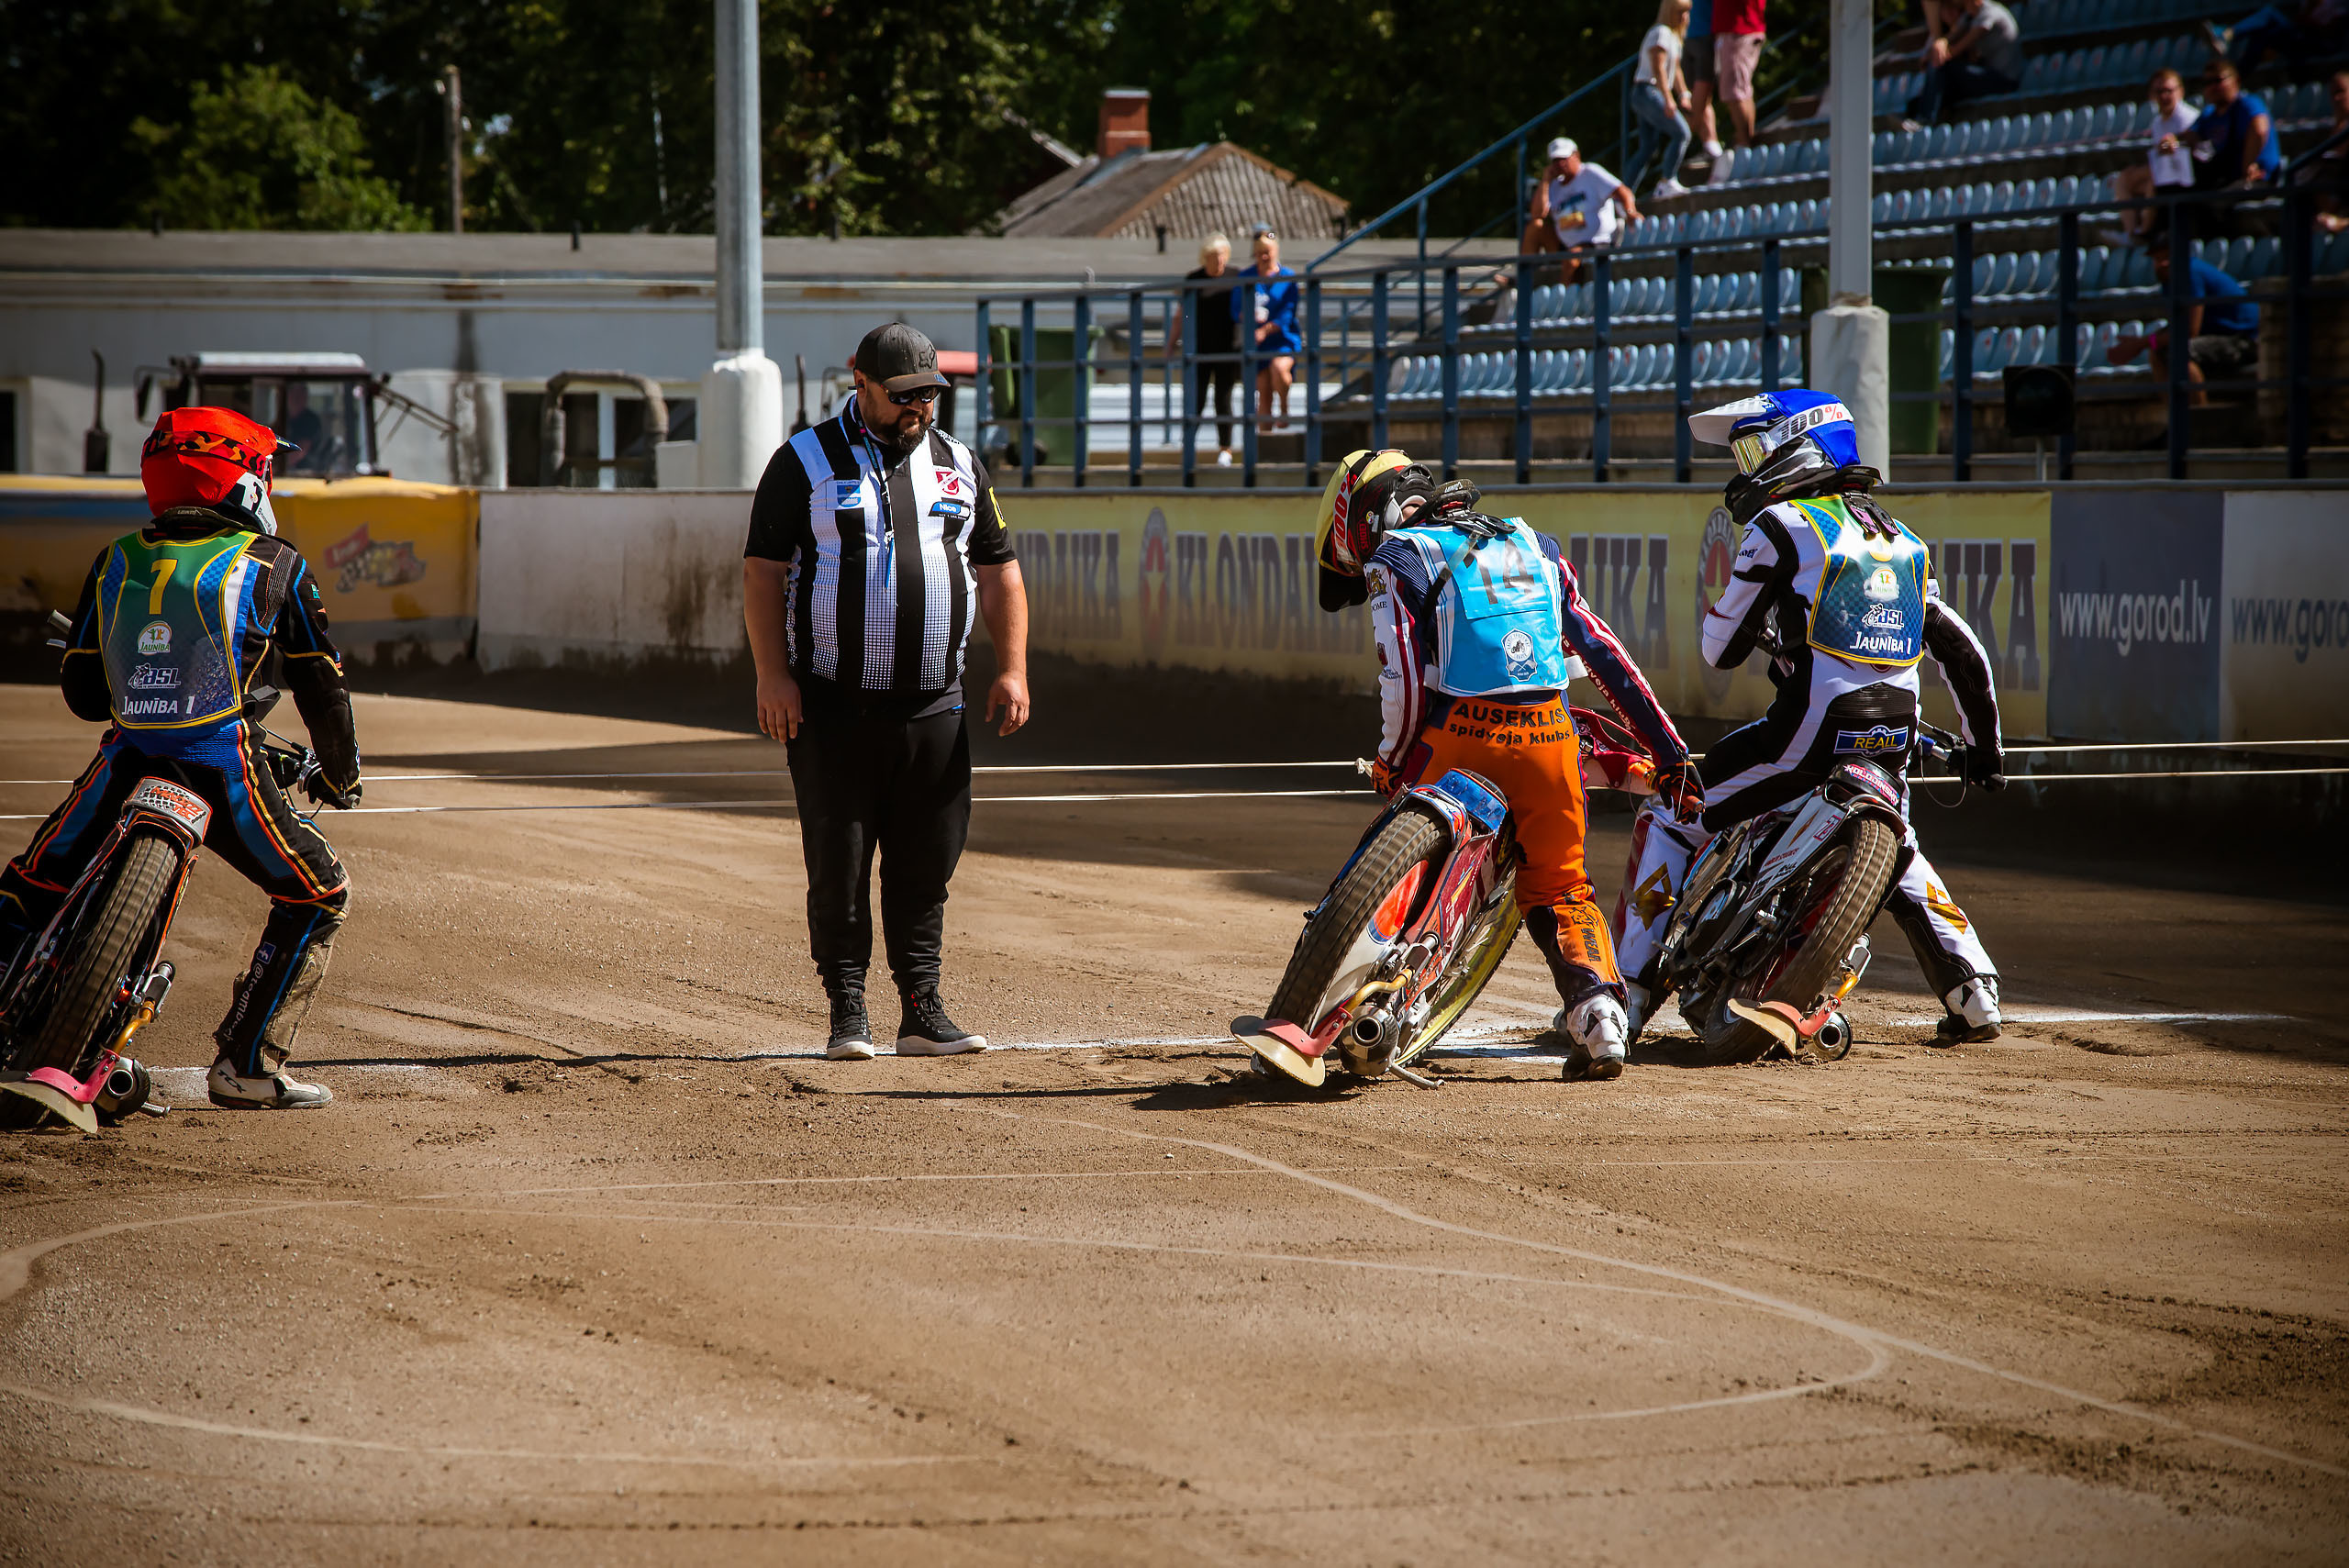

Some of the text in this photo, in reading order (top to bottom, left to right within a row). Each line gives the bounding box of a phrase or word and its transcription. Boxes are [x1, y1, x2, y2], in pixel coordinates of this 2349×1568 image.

[1781, 405, 1843, 442] 100%
[149, 559, 178, 615] 7
[1464, 538, 1535, 606] 14
[1371, 601, 1387, 612] OME
[2059, 579, 2212, 657] www.gorod.lv
[1453, 703, 1565, 728] AUSEKLIS
[1449, 723, 1570, 746] spīdveja klubs
[1854, 735, 1898, 750] REALL
[1581, 928, 1602, 962] WEAR
